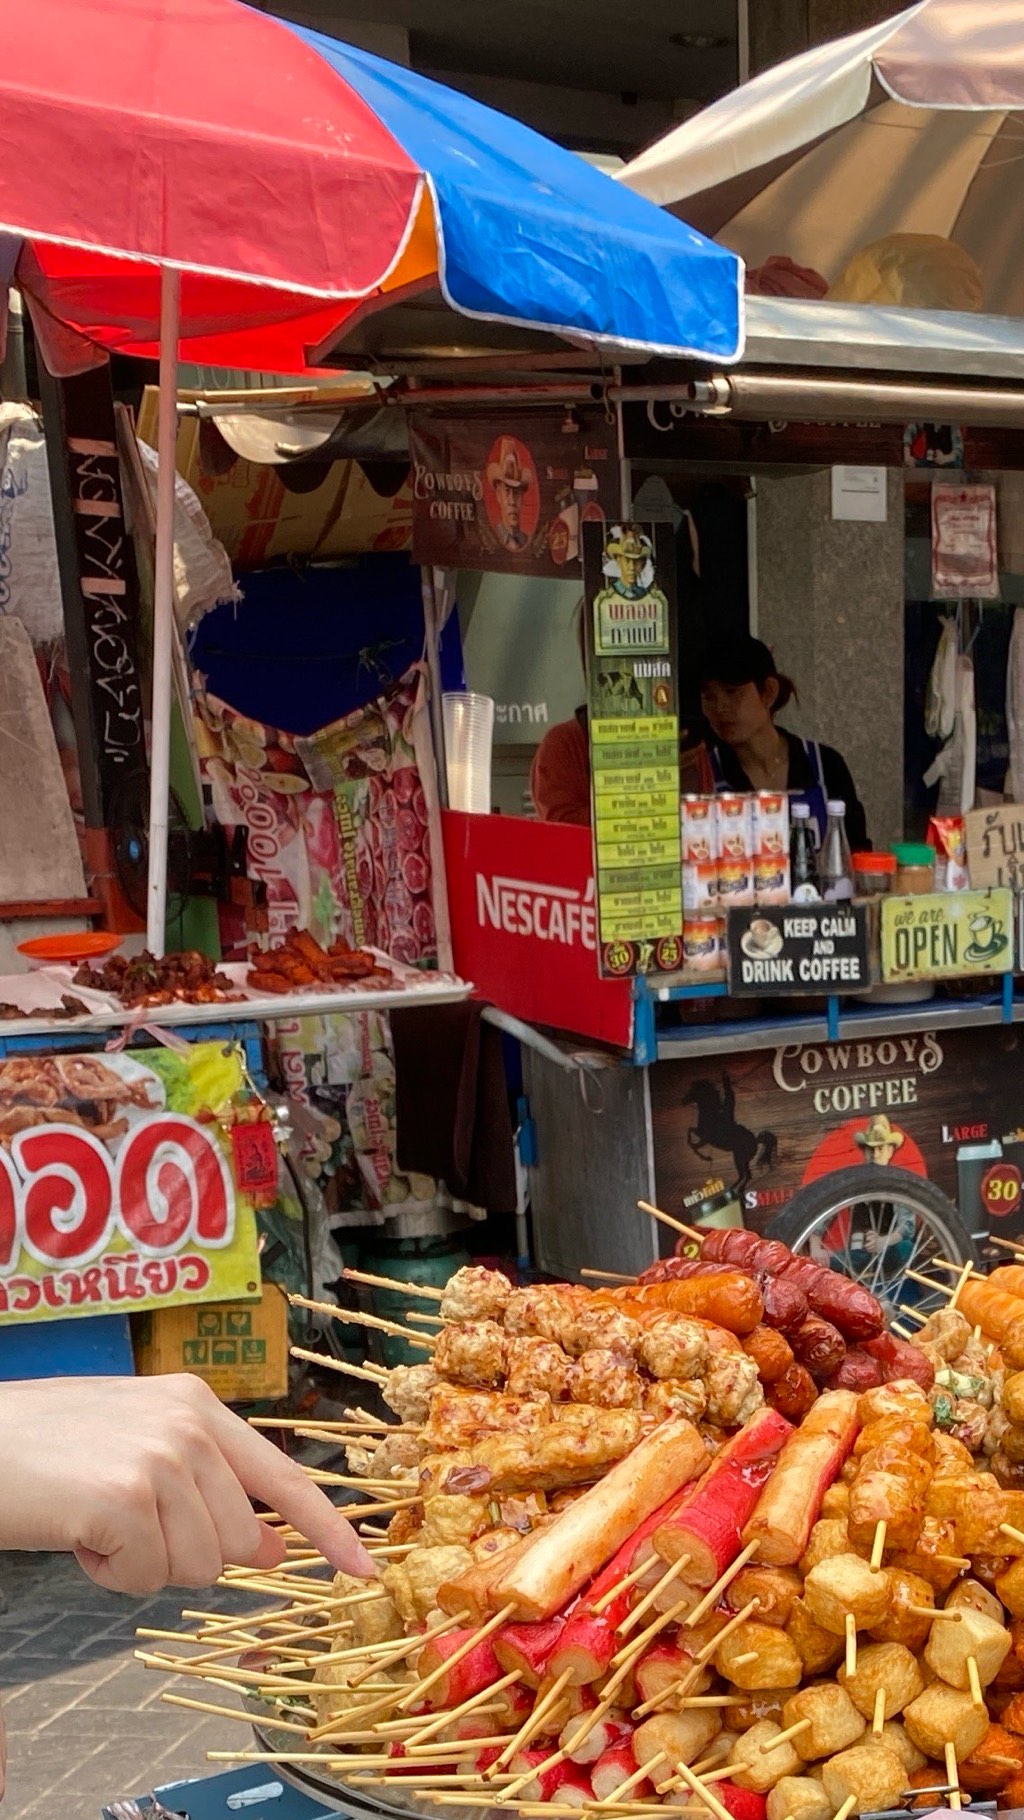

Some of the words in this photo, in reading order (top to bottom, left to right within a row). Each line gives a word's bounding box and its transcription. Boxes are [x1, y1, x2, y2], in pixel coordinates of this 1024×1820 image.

[430, 502, 475, 521] COFFEE
[494, 702, 549, 724] ะกาศ
[335, 794, 355, 840] juice
[340, 841, 366, 946] omegranate
[475, 872, 597, 951] NESCAFÉ
[894, 908, 914, 926] we
[919, 906, 945, 925] are
[783, 918, 818, 939] KEEP
[820, 917, 857, 938] CALM
[813, 939, 835, 955] AND
[895, 922, 958, 969] OPEN
[741, 959, 795, 983] DRINK
[799, 957, 861, 982] COFFEE
[772, 1031, 944, 1092] COWBOYS
[813, 1076, 918, 1114] COFFEE
[942, 1123, 988, 1143] LARGE
[988, 1179, 1019, 1201] 30
